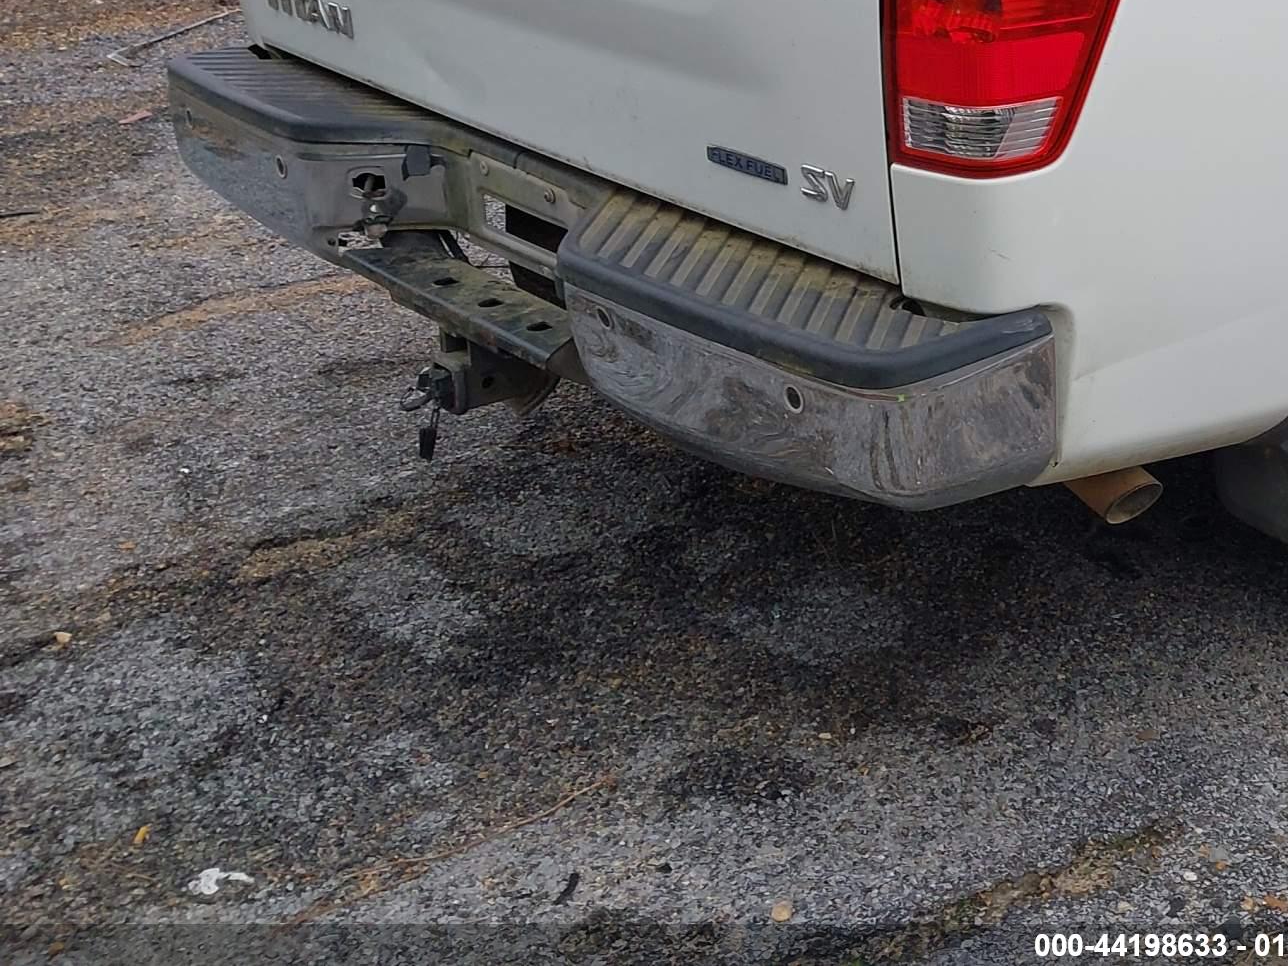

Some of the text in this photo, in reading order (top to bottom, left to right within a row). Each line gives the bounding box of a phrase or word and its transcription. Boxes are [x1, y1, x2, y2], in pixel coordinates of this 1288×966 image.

[710, 150, 782, 181] FLEX FUEL
[800, 163, 855, 210] SV
